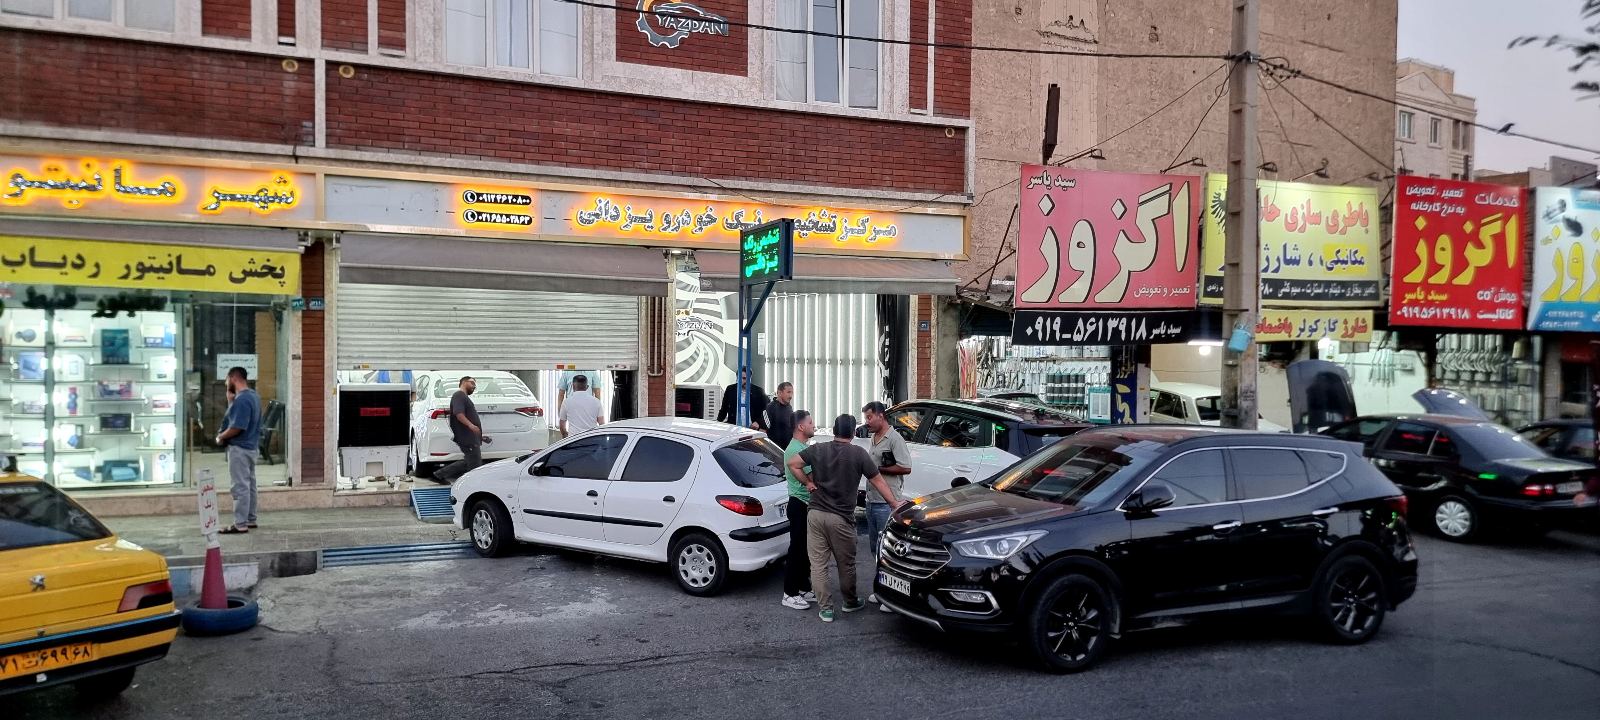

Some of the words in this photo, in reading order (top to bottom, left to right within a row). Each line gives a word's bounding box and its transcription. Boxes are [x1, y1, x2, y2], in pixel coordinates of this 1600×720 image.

[656, 15, 729, 36] YAZDAN
[1026, 169, 1052, 190] یاسر
[1054, 174, 1076, 191] سید
[203, 175, 294, 211] شهر
[1406, 185, 1436, 197] تعویض
[1441, 187, 1465, 199] تعمیر
[1475, 191, 1519, 208] خدمات
[577, 197, 655, 231] یزدانی
[659, 206, 718, 234] خودرو
[794, 209, 837, 237] تشخی
[1284, 198, 1321, 233] سازی
[1325, 200, 1370, 235] باطری
[838, 215, 897, 242] مرکز
[1020, 180, 1192, 303] اگزوز
[1402, 213, 1519, 286] اگزوز
[1, 244, 101, 279] ردیاب
[117, 252, 216, 282] مانیتور
[1261, 242, 1301, 274] شارژ
[228, 256, 286, 288] پخش
[1133, 283, 1162, 298] تعویض
[1162, 287, 1168, 297] و
[1169, 285, 1191, 297] تعمیر
[1401, 286, 1425, 305] یاسر
[1427, 289, 1448, 304] سید
[1476, 308, 1516, 322] کاتالیست
[1149, 321, 1166, 339] یاسر
[1167, 323, 1182, 337] سید
[1296, 318, 1320, 338] کولر
[1341, 317, 1368, 338] شارژ
